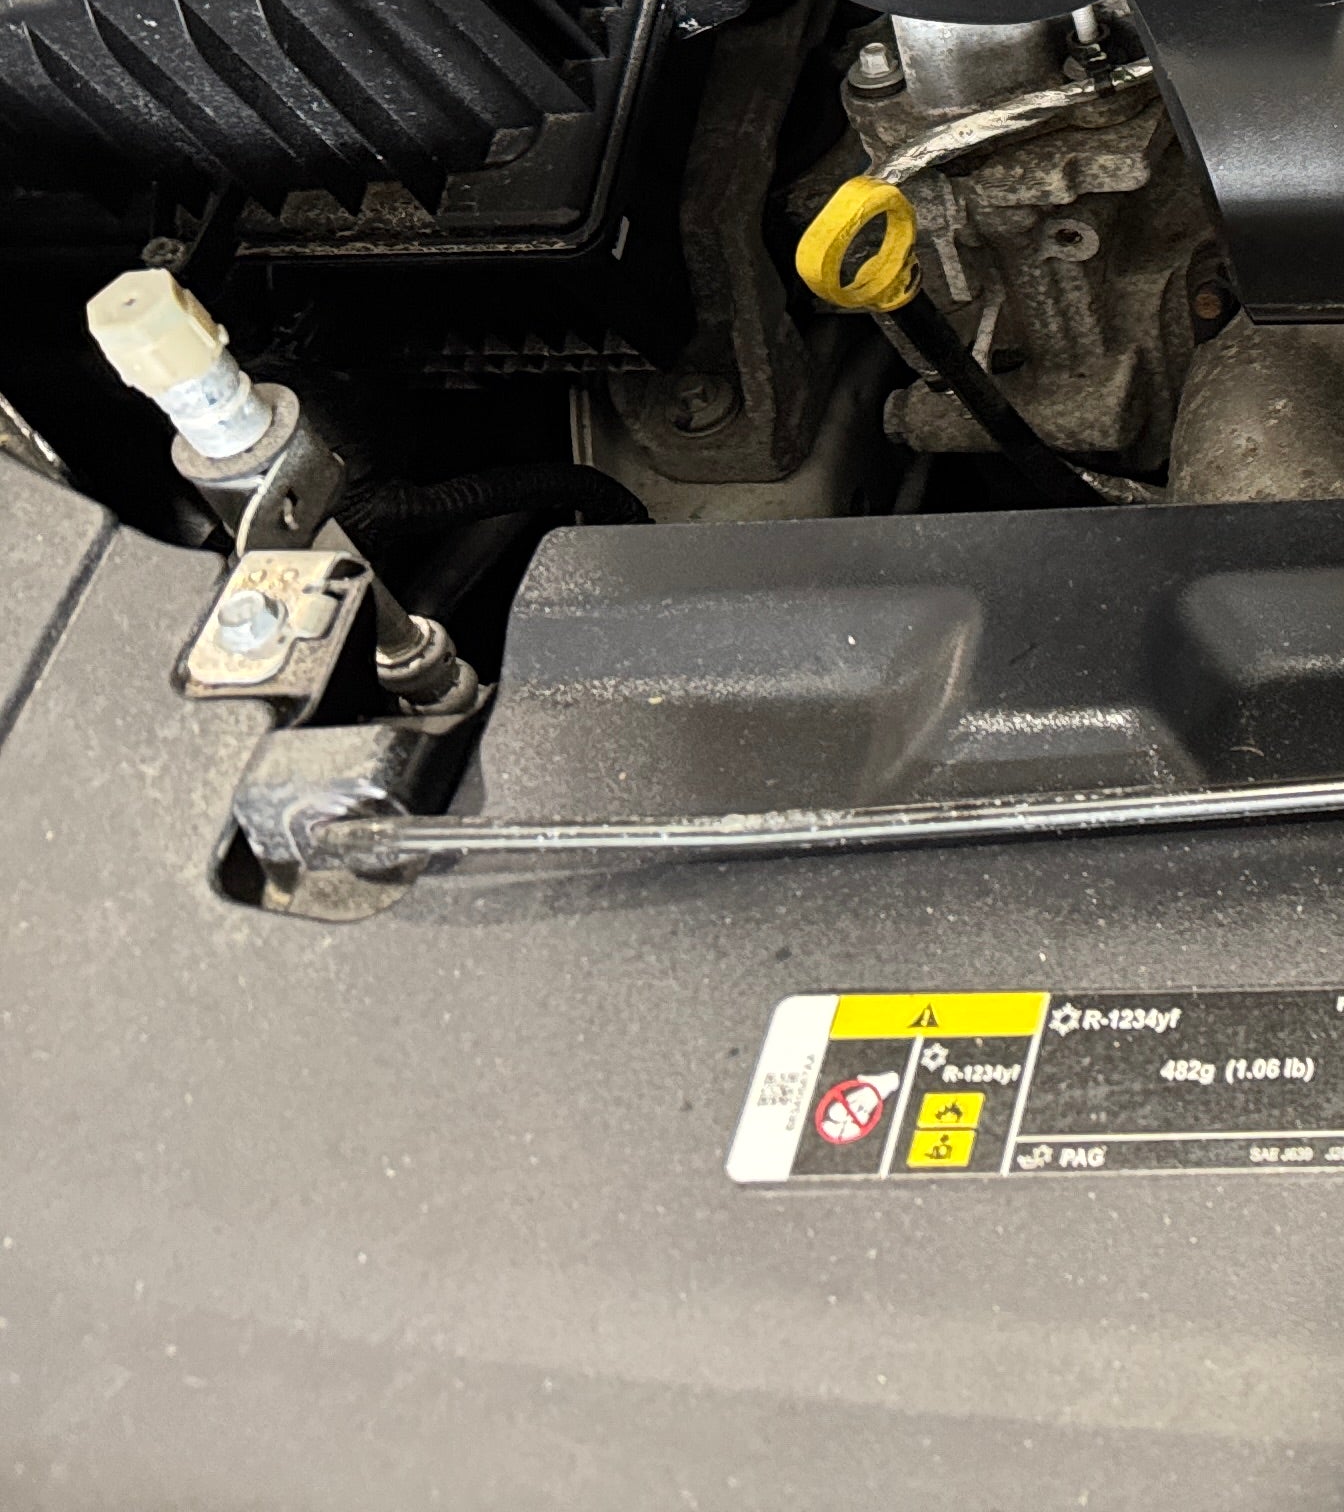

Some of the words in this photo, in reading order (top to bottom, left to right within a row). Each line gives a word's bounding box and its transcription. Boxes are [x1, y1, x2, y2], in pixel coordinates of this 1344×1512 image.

[1082, 1007, 1183, 1034] R-1234yf
[941, 1063, 1023, 1086] R-1234yf
[1159, 1059, 1217, 1085] 482g
[1224, 1058, 1280, 1084] (1.06
[1282, 1056, 1316, 1083] lb)
[1058, 1147, 1107, 1169] PAG
[1249, 1146, 1280, 1163] SAE
